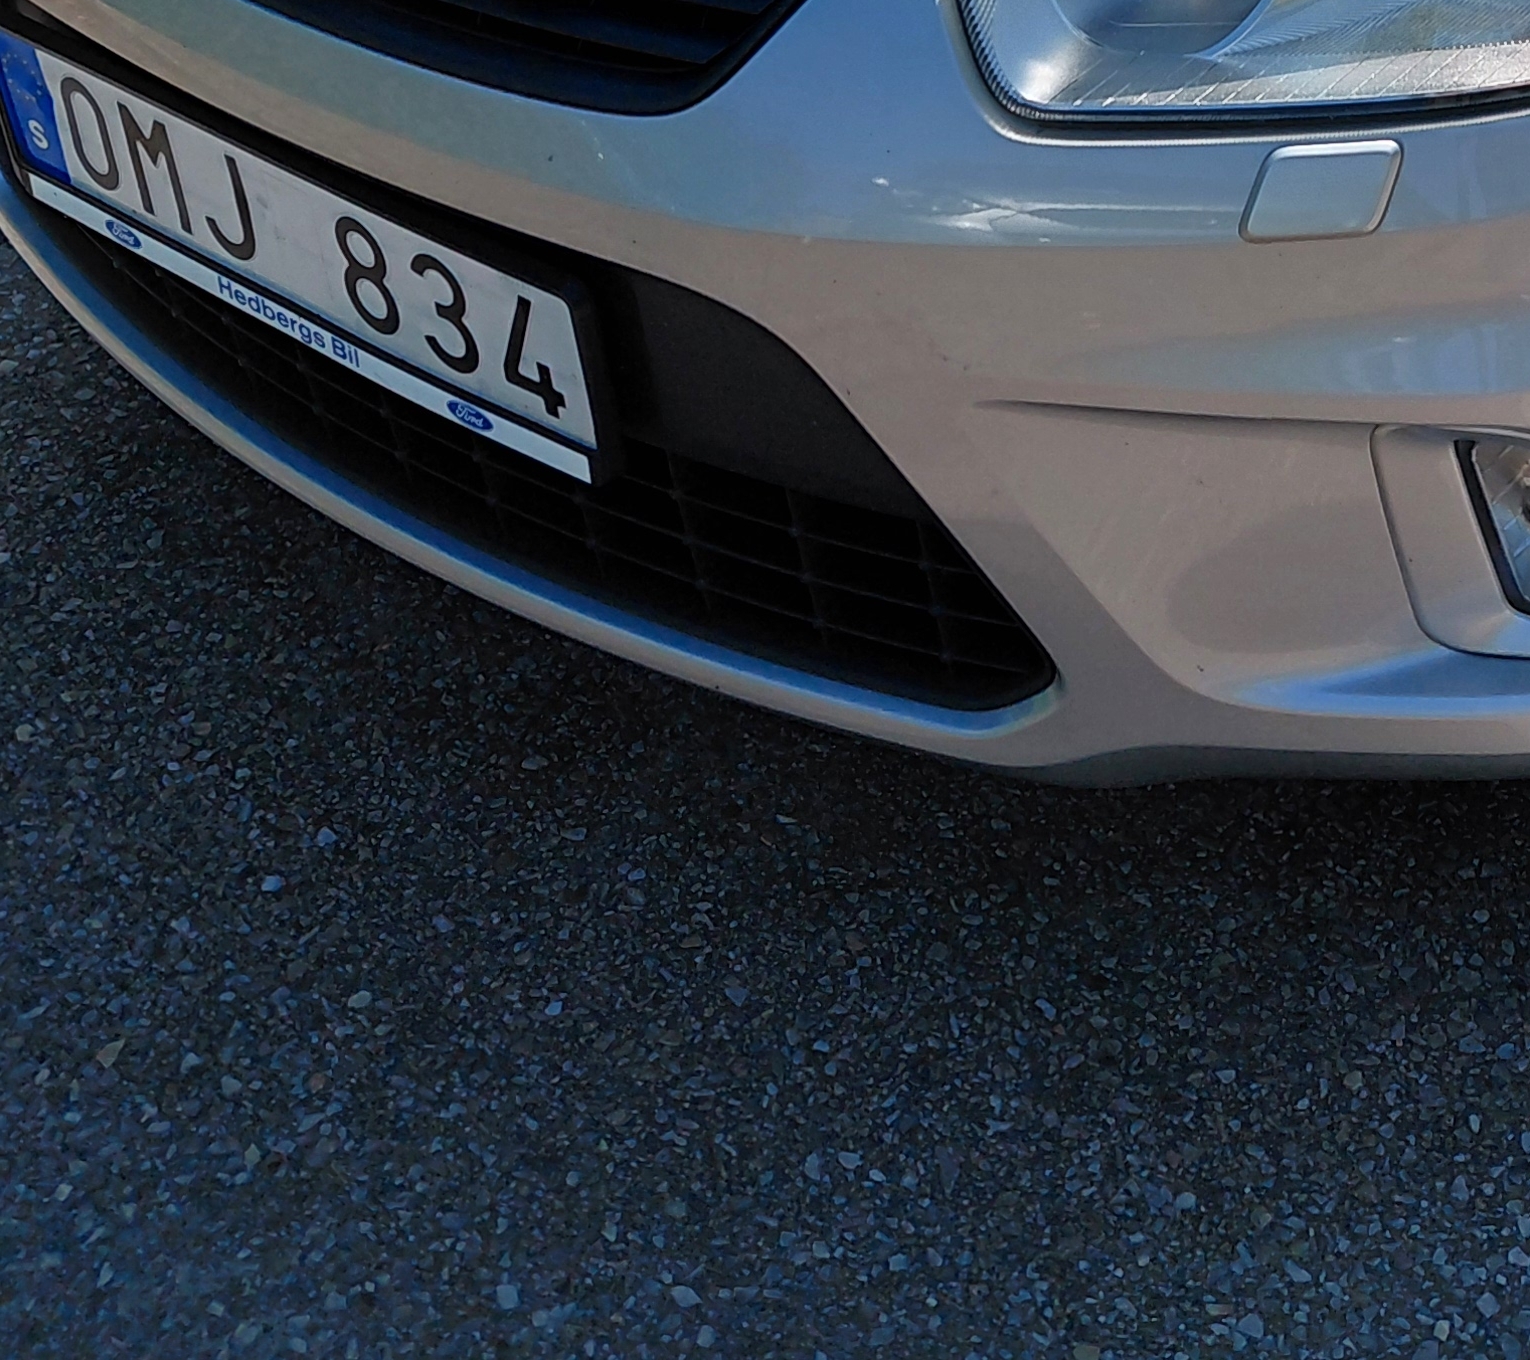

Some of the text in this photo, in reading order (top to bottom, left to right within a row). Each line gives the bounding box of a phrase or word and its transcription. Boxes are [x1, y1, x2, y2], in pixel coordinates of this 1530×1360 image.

[28, 119, 49, 151] S
[60, 77, 567, 419] OMJ 834
[217, 275, 360, 368] Hedbergs Bil
